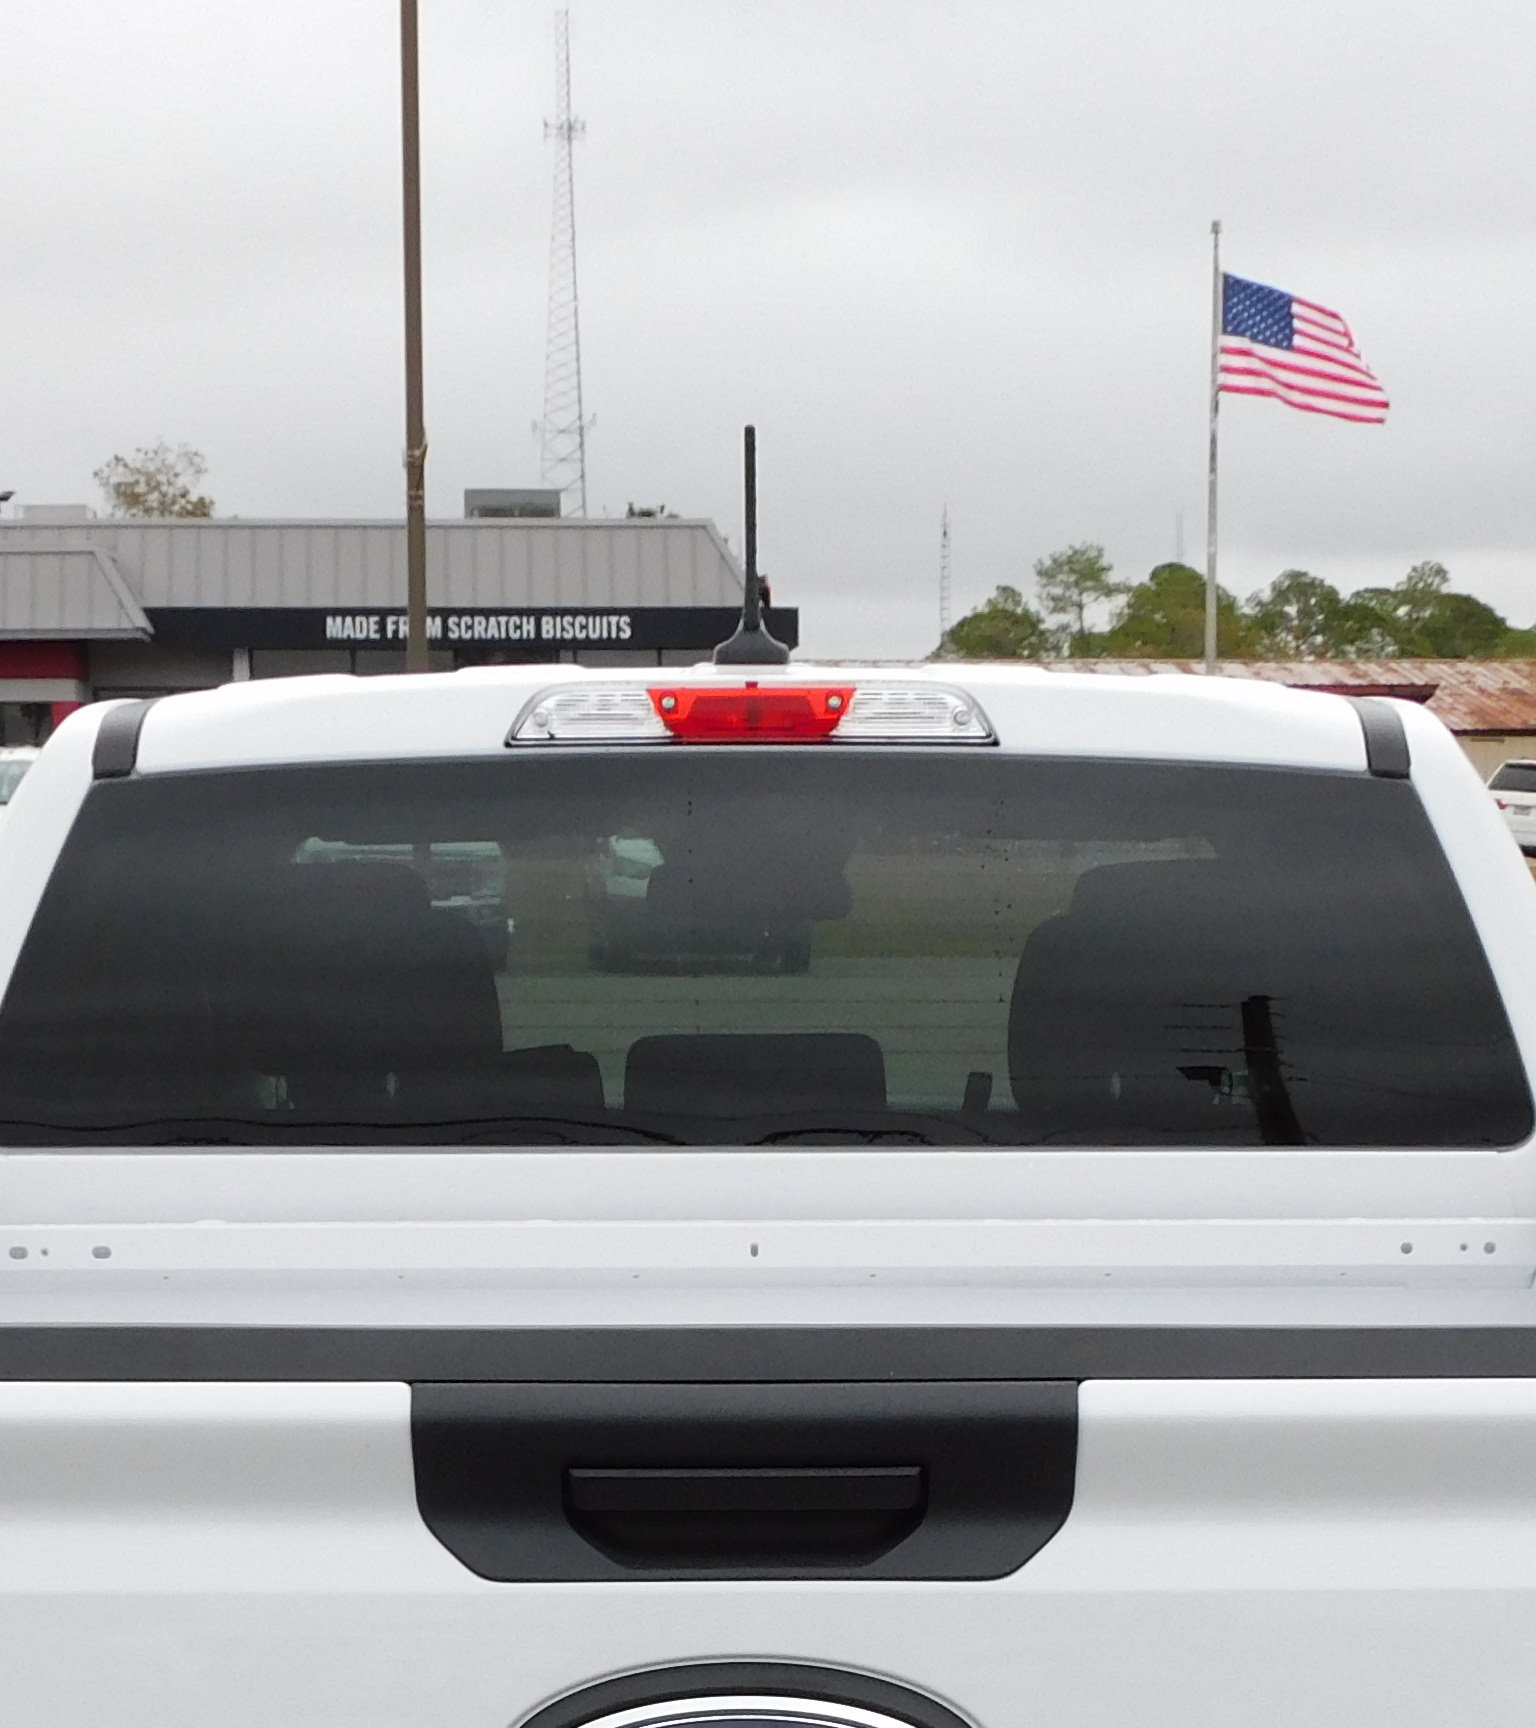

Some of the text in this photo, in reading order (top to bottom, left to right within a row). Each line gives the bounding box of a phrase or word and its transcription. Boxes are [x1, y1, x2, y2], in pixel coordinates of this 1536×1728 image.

[325, 615, 632, 640] MADE FRM SCRATCH BISCUITS
